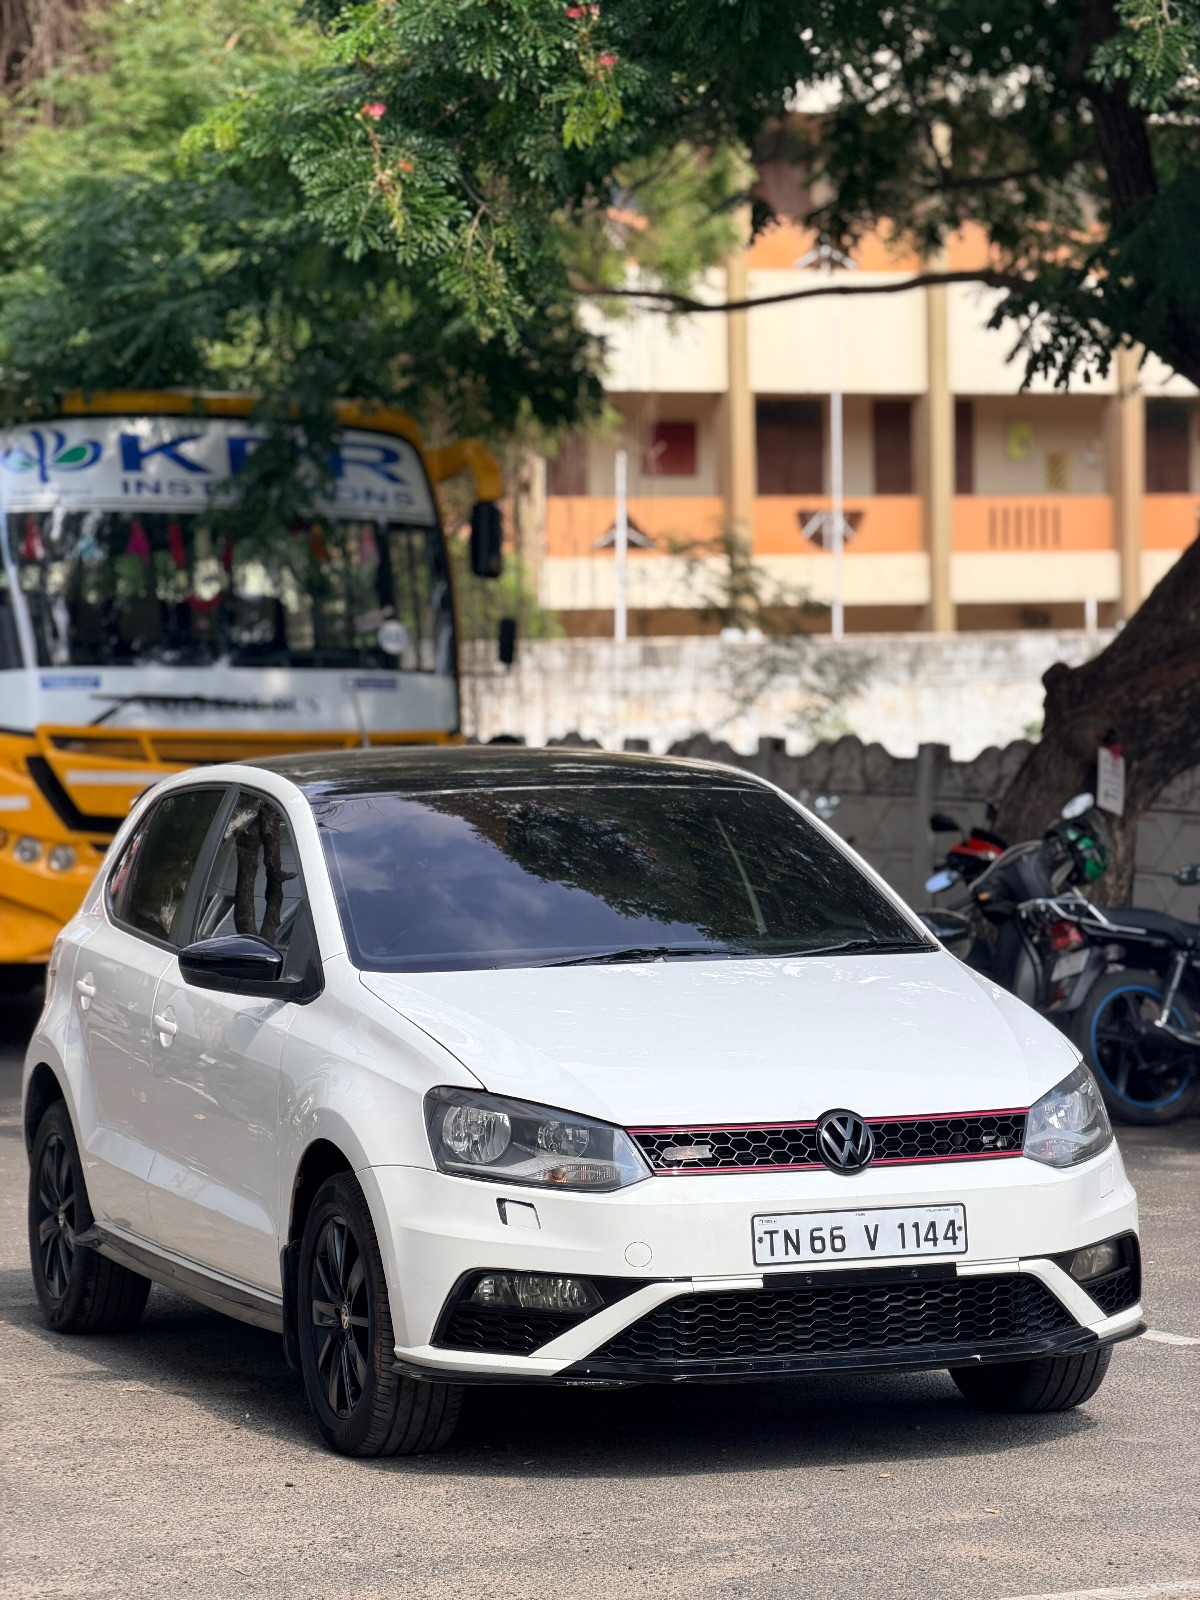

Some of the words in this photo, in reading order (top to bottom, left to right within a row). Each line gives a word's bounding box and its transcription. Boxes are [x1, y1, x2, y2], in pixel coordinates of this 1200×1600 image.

[763, 1228, 801, 1257] TN
[809, 1226, 847, 1254] 66
[863, 1223, 879, 1251] V
[897, 1219, 958, 1250] 1144
